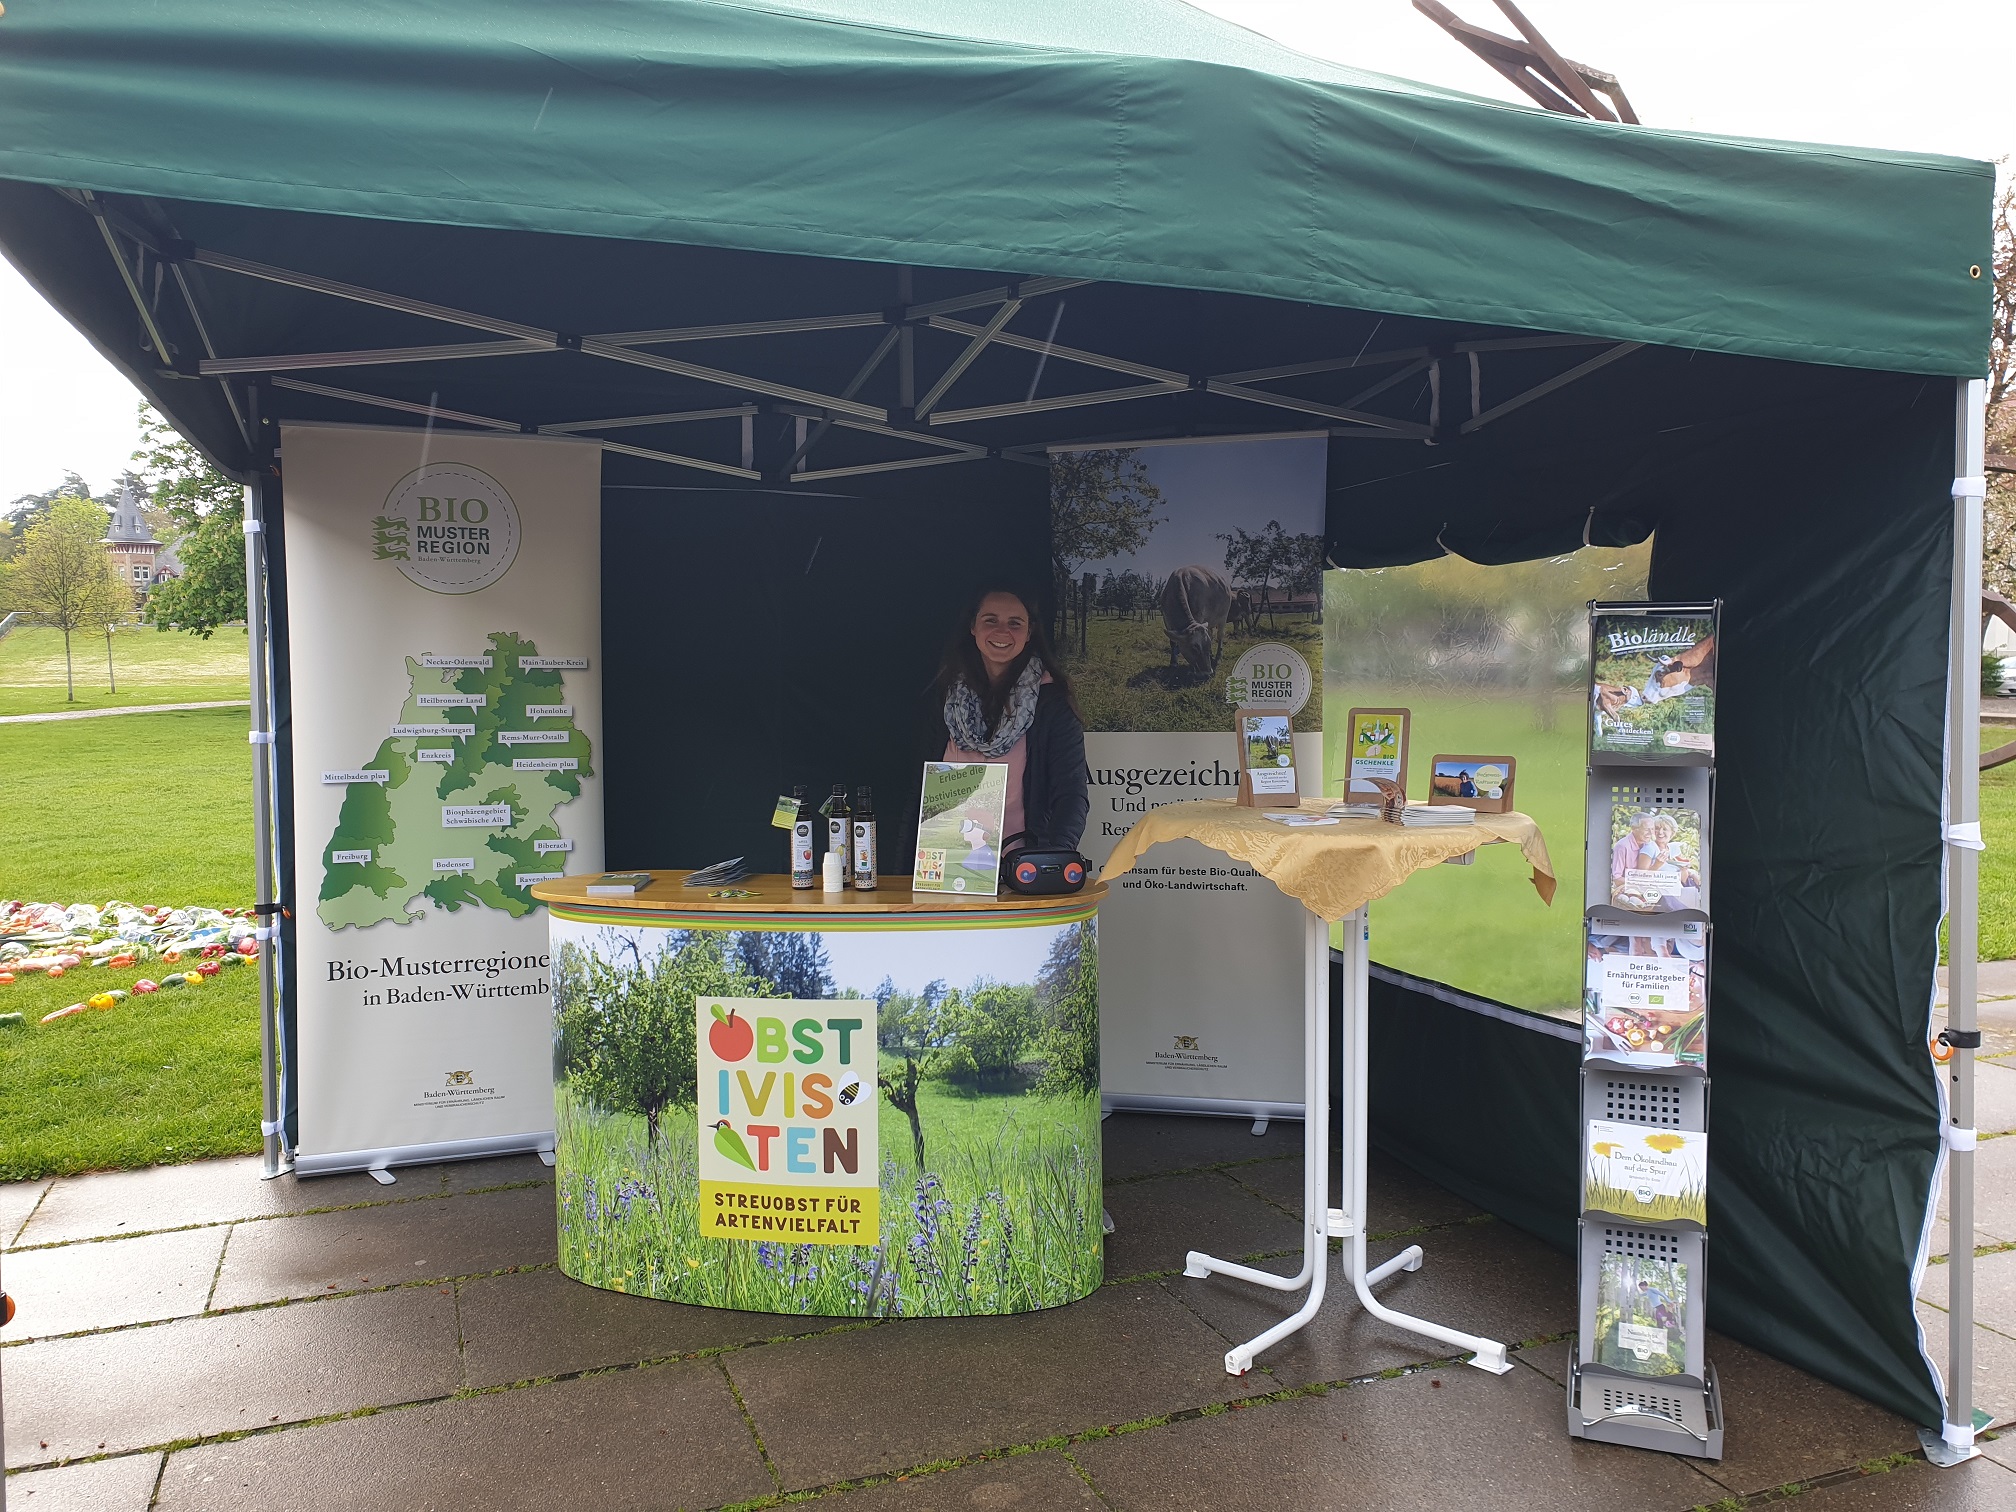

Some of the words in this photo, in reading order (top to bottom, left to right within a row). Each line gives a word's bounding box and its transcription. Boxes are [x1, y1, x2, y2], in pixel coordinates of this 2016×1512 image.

[417, 496, 489, 524] BIO
[417, 526, 490, 541] MUSTER
[417, 541, 490, 555] REGION
[418, 556, 482, 565] Baden-Württemberg
[1608, 626, 1697, 650] Bioländle
[425, 658, 490, 667] Neckar-Odenwald
[521, 659, 585, 667] Main-Tauber-Kreis
[1252, 663, 1292, 680] BIO
[1251, 681, 1292, 689] MUSTER
[1251, 690, 1292, 698] REGION
[420, 697, 463, 705] Heilbronner
[529, 707, 568, 715] Hohenlohe
[1605, 718, 1633, 728] Gutes
[392, 726, 472, 735] Ludwigsburg-Stuttgart
[501, 733, 565, 742] Rems-Murr-Ostalb
[421, 752, 452, 760] Enzkreis
[516, 760, 557, 768] Heidenheim
[559, 760, 575, 769] plus
[324, 773, 369, 781] Mittelbaden
[370, 773, 386, 781] plus
[939, 769, 968, 784] Erlebe
[969, 765, 984, 776] die
[923, 785, 972, 805] Obstivisten
[1110, 797, 1146, 812] Und
[446, 808, 507, 817] Biosphärengebiet
[446, 816, 490, 825] Schwäbische
[491, 816, 505, 824] Alb
[537, 841, 568, 849] Biberach
[336, 853, 368, 861] Freiburg
[922, 870, 941, 880] TEN
[1161, 865, 1176, 875] für
[1179, 866, 1206, 876] beste
[1122, 880, 1142, 889] und
[1144, 879, 1248, 891] Öko-Landwirtschaft.
[1629, 963, 1643, 971] Der
[1645, 963, 1662, 971] Bio-
[1607, 971, 1685, 983] Ernährungsratgeber
[1635, 982, 1670, 990] Familien
[363, 990, 381, 1006] in
[386, 978, 551, 1006] Baden-Württemb
[1155, 1052, 1218, 1063] Baden-Württemberg
[424, 1087, 495, 1099] Baden-Württemberg
[746, 1124, 859, 1174] TEN
[1633, 1153, 1677, 1167] Ökolandbau
[1624, 1165, 1635, 1173] auf
[1636, 1165, 1648, 1173] der
[1649, 1166, 1667, 1176] Spur
[714, 1192, 820, 1213] STREUOBST
[825, 1195, 862, 1213] FÜR
[715, 1212, 861, 1234] ARTENVIELFALT
